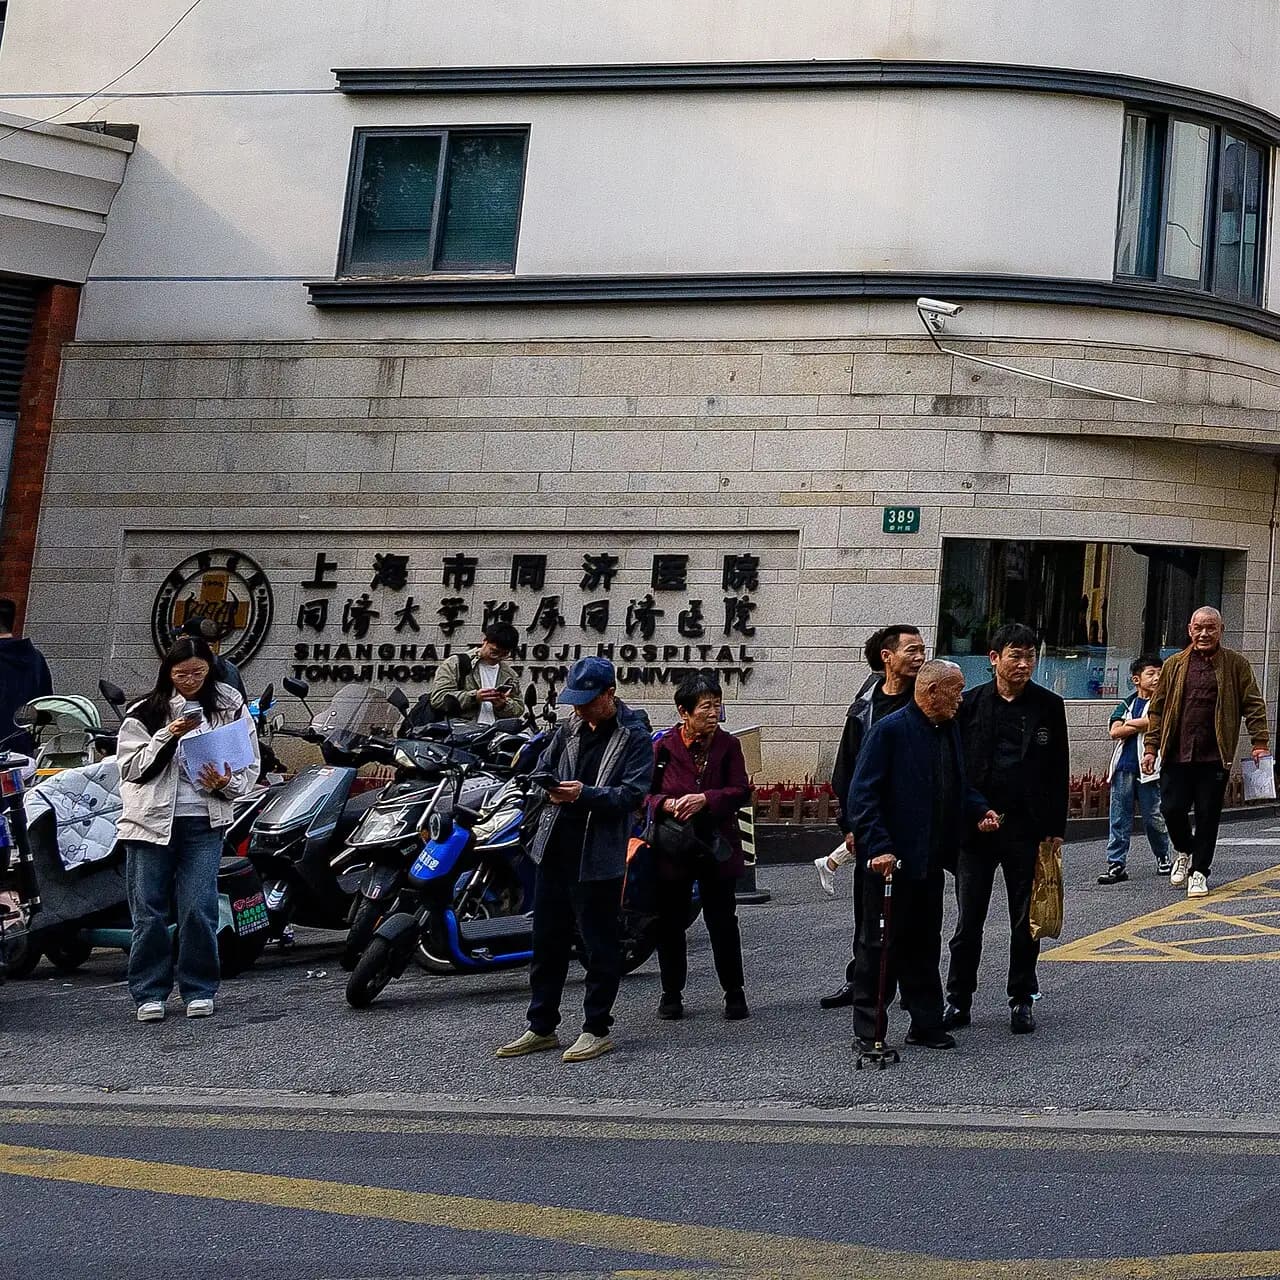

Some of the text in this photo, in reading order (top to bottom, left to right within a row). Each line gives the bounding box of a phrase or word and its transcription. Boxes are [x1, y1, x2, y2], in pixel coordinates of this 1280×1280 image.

[888, 510, 915, 523] 389
[301, 552, 761, 591] 上海市同济医院
[293, 643, 453, 661] SHANGHAI
[597, 643, 755, 663] HOSPITAL
[291, 664, 373, 683] TONGJI
